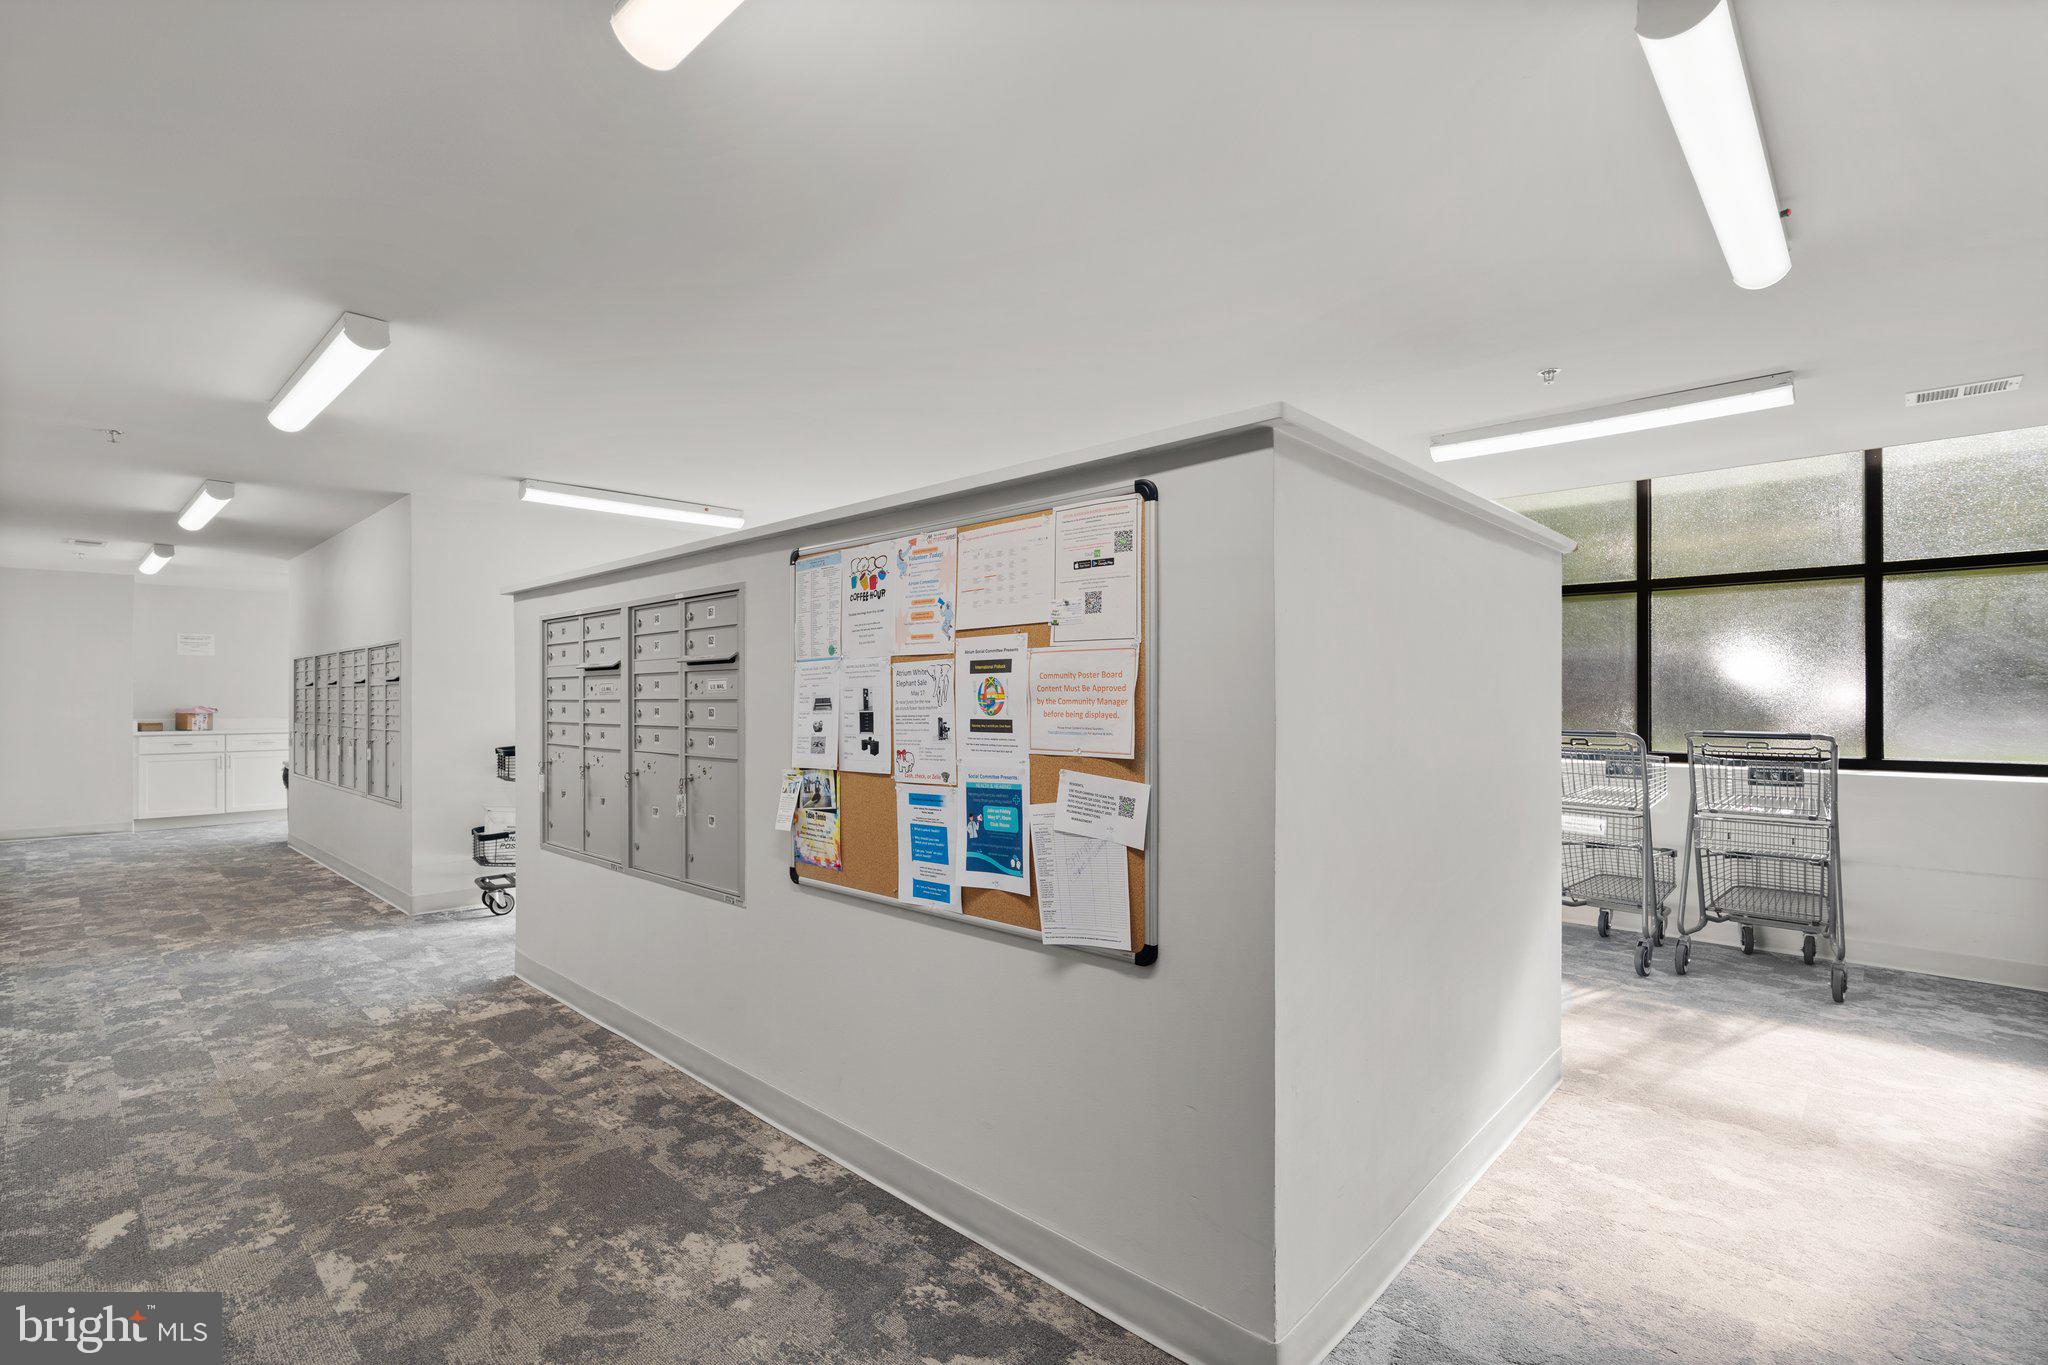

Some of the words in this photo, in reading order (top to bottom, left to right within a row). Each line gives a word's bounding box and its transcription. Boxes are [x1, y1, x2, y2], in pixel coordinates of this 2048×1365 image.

[850, 592, 868, 602] COFFEE
[870, 588, 886, 600] HOUR
[1040, 672, 1076, 680] Community
[1102, 670, 1122, 678] Board
[1092, 684, 1127, 693] Approved
[1058, 698, 1095, 706] Community
[1097, 698, 1128, 707] Manager
[1066, 711, 1084, 719] being
[1085, 711, 1120, 720] displayed.
[806, 810, 814, 818] Table
[815, 812, 826, 821] Tennis
